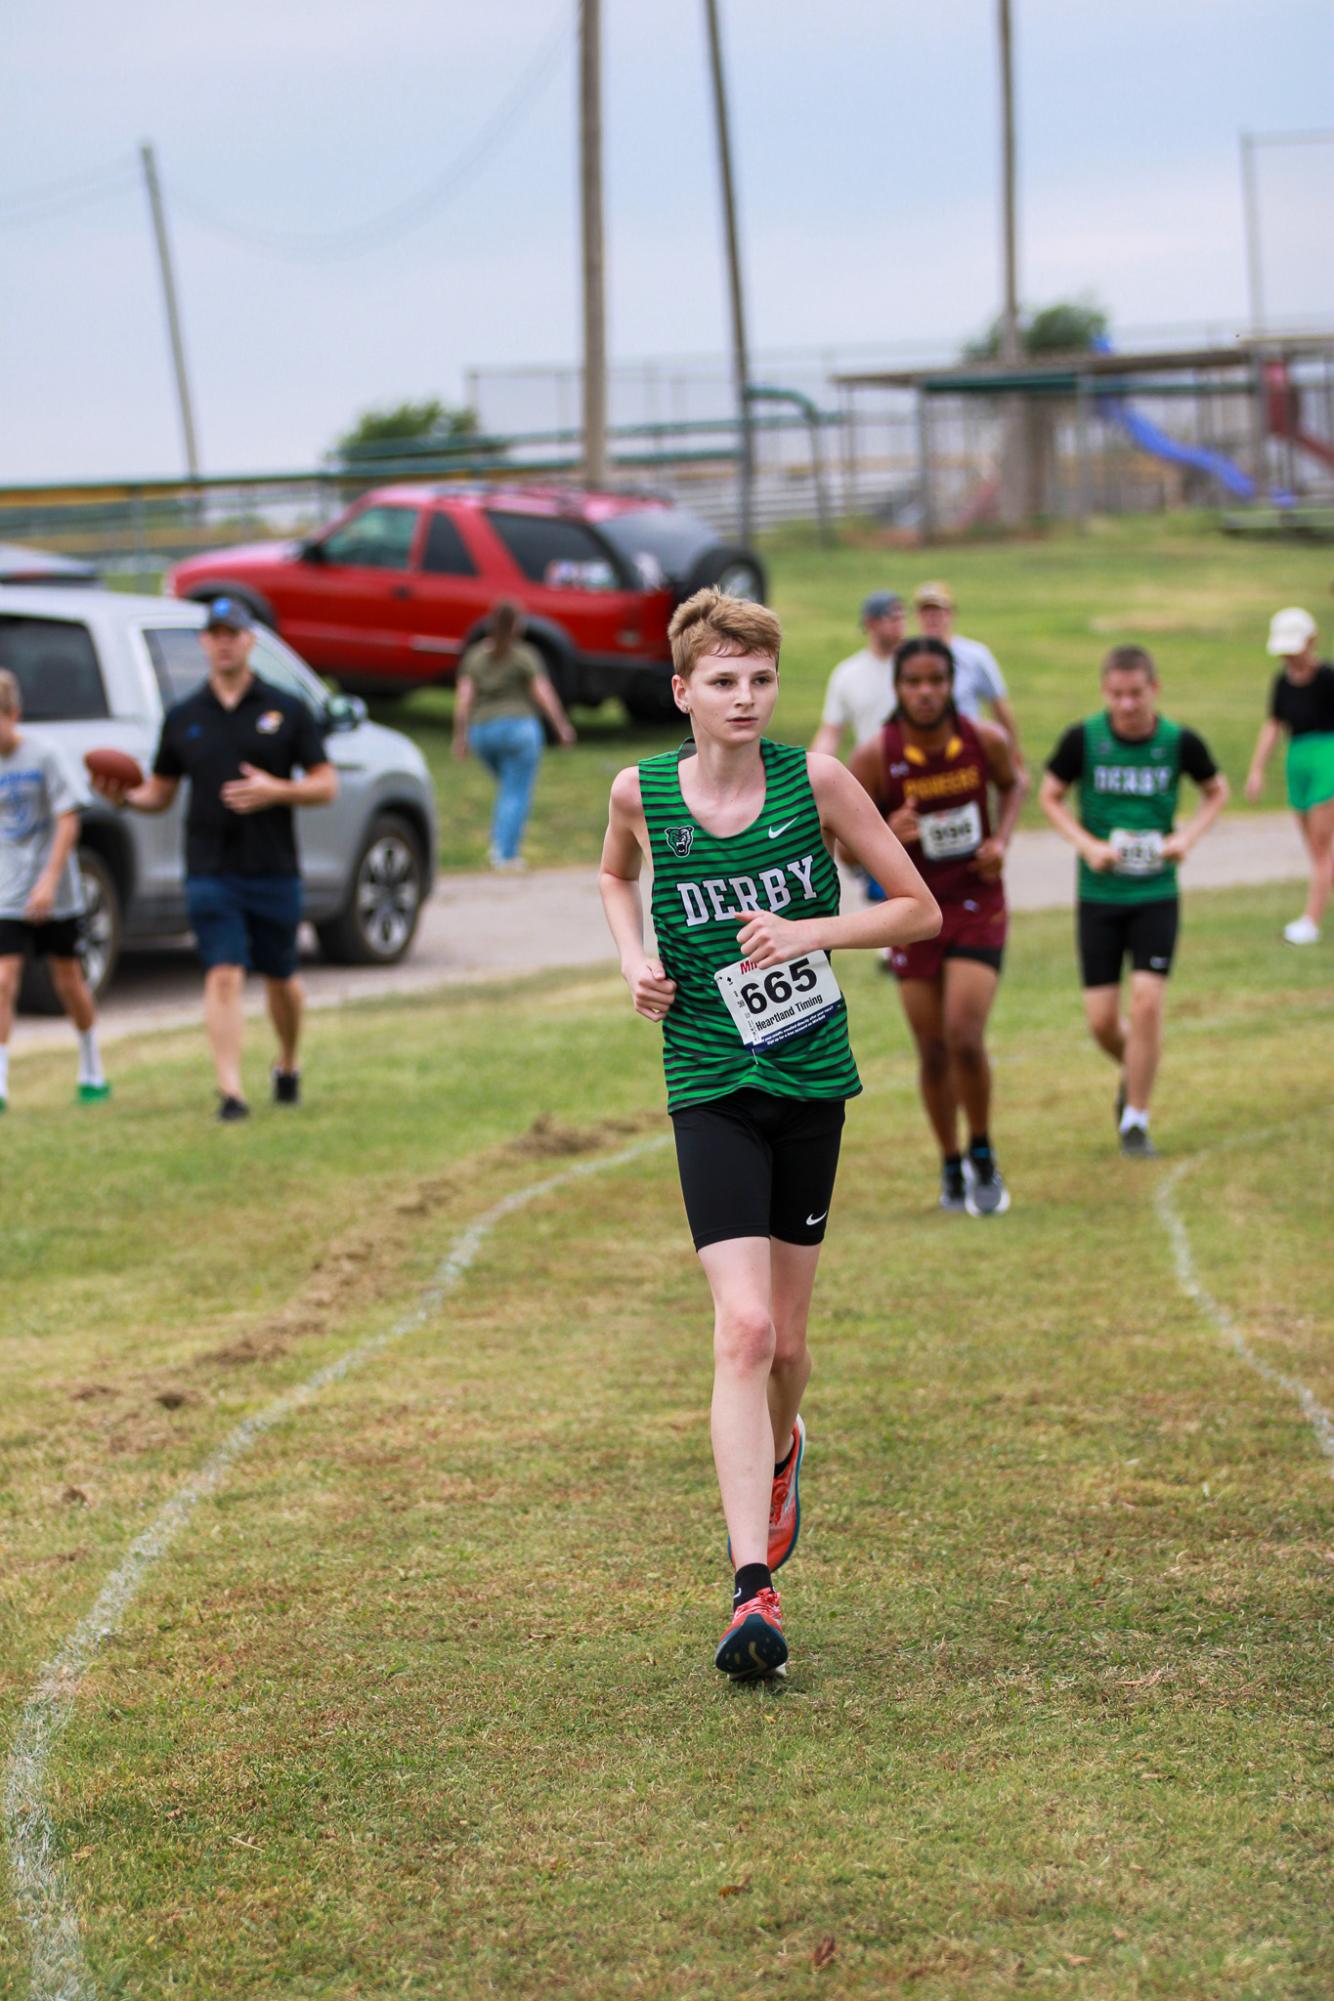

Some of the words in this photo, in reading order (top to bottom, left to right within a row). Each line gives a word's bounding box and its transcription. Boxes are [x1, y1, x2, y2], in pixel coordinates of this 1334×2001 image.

[1094, 765, 1171, 795] DERBY
[676, 855, 817, 927] DERBY
[740, 957, 817, 1015] 665
[755, 1006, 796, 1031] Heartland
[794, 994, 823, 1013] Timing
